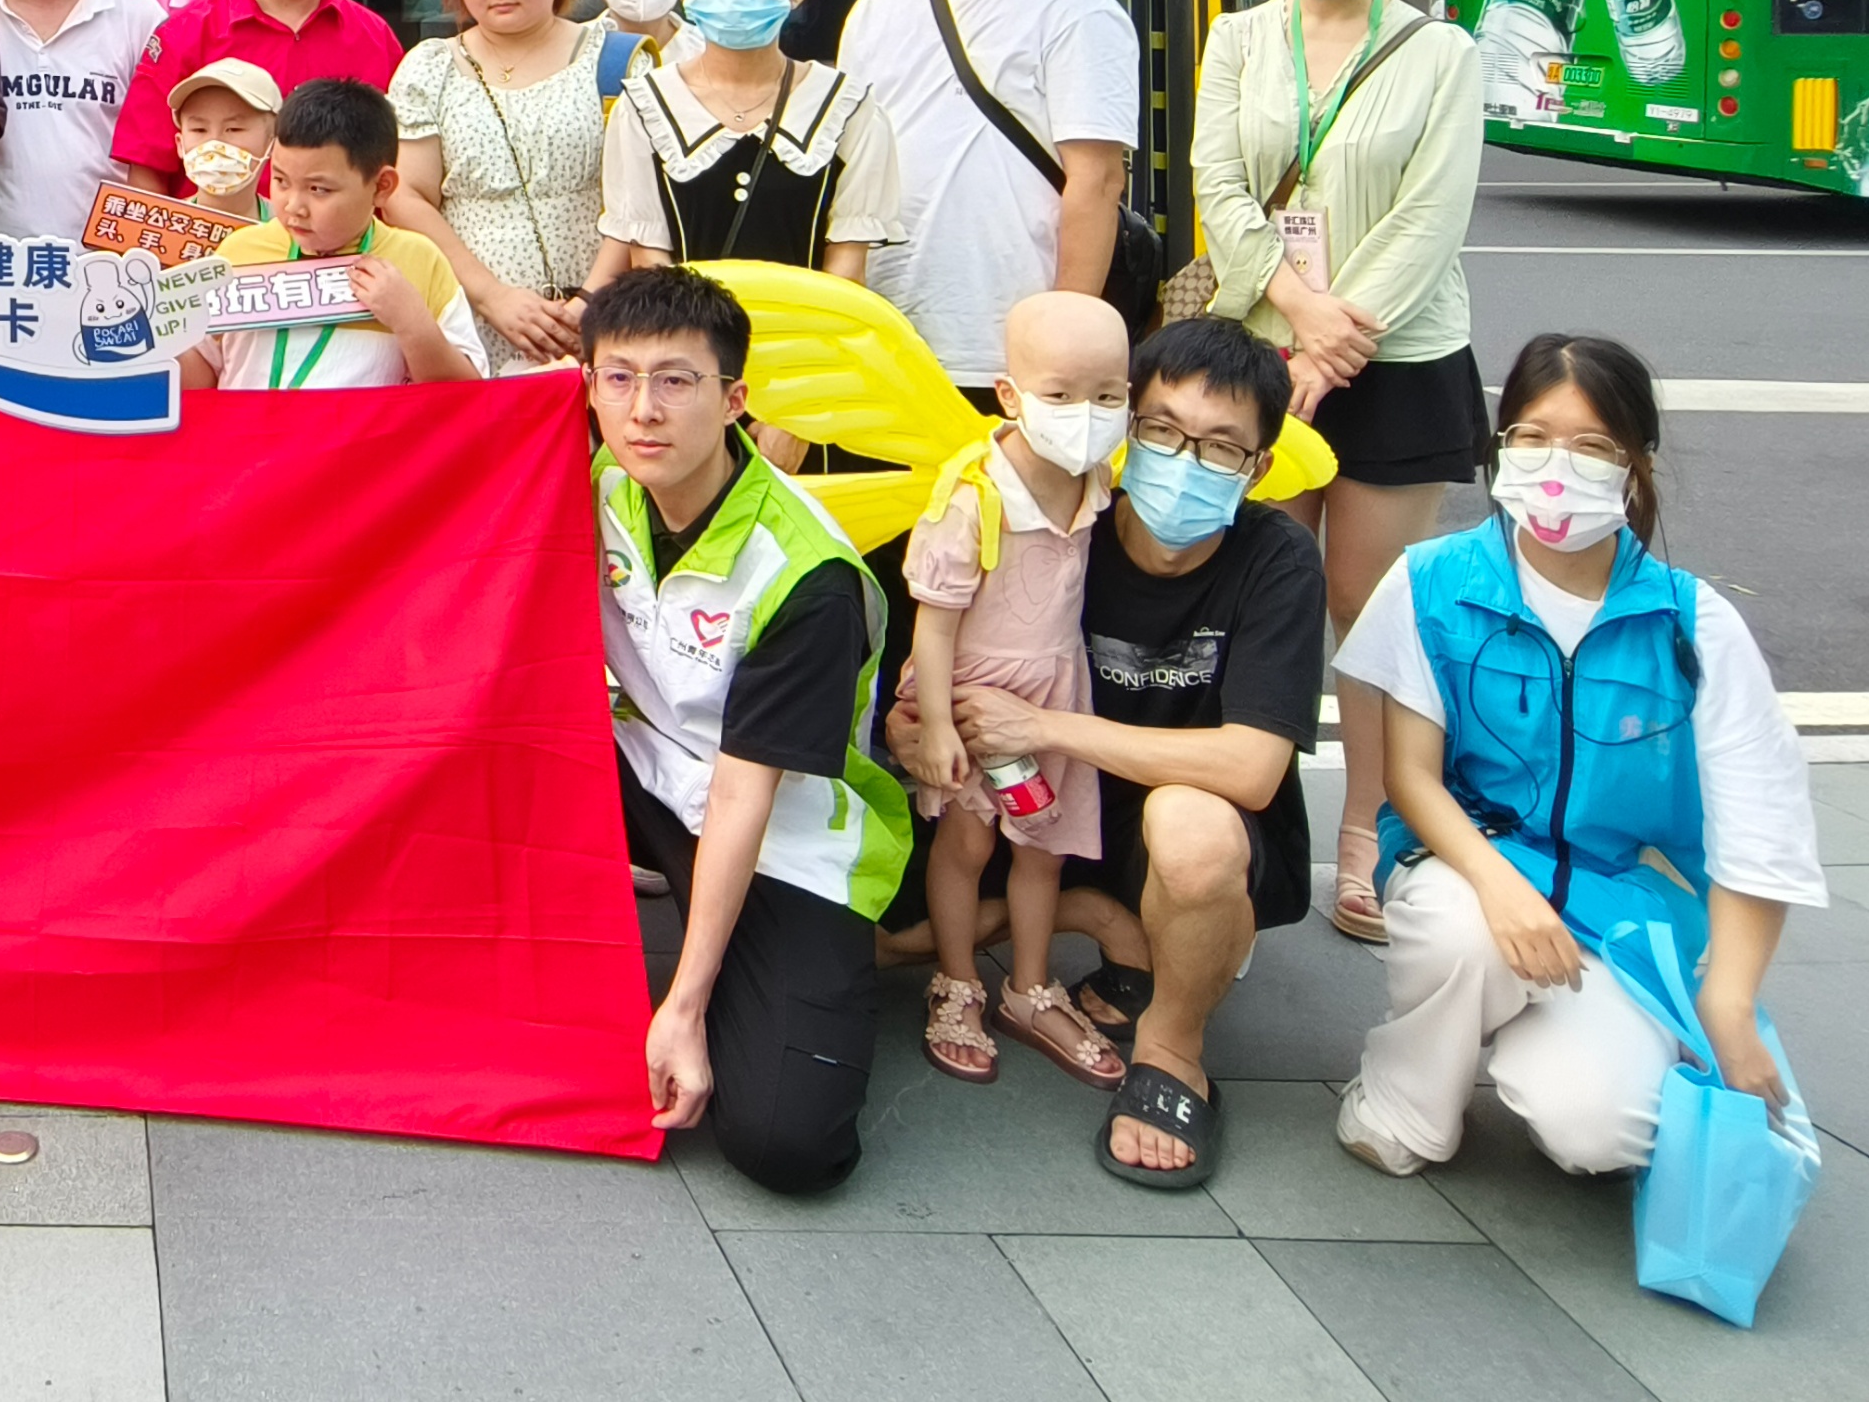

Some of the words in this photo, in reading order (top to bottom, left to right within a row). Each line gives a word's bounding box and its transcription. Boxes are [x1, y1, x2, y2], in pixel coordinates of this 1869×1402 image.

[156, 263, 227, 292] NEVER
[155, 295, 203, 315] GIVE
[155, 317, 188, 337] UP!
[1100, 665, 1213, 688] CONFIDENCE
